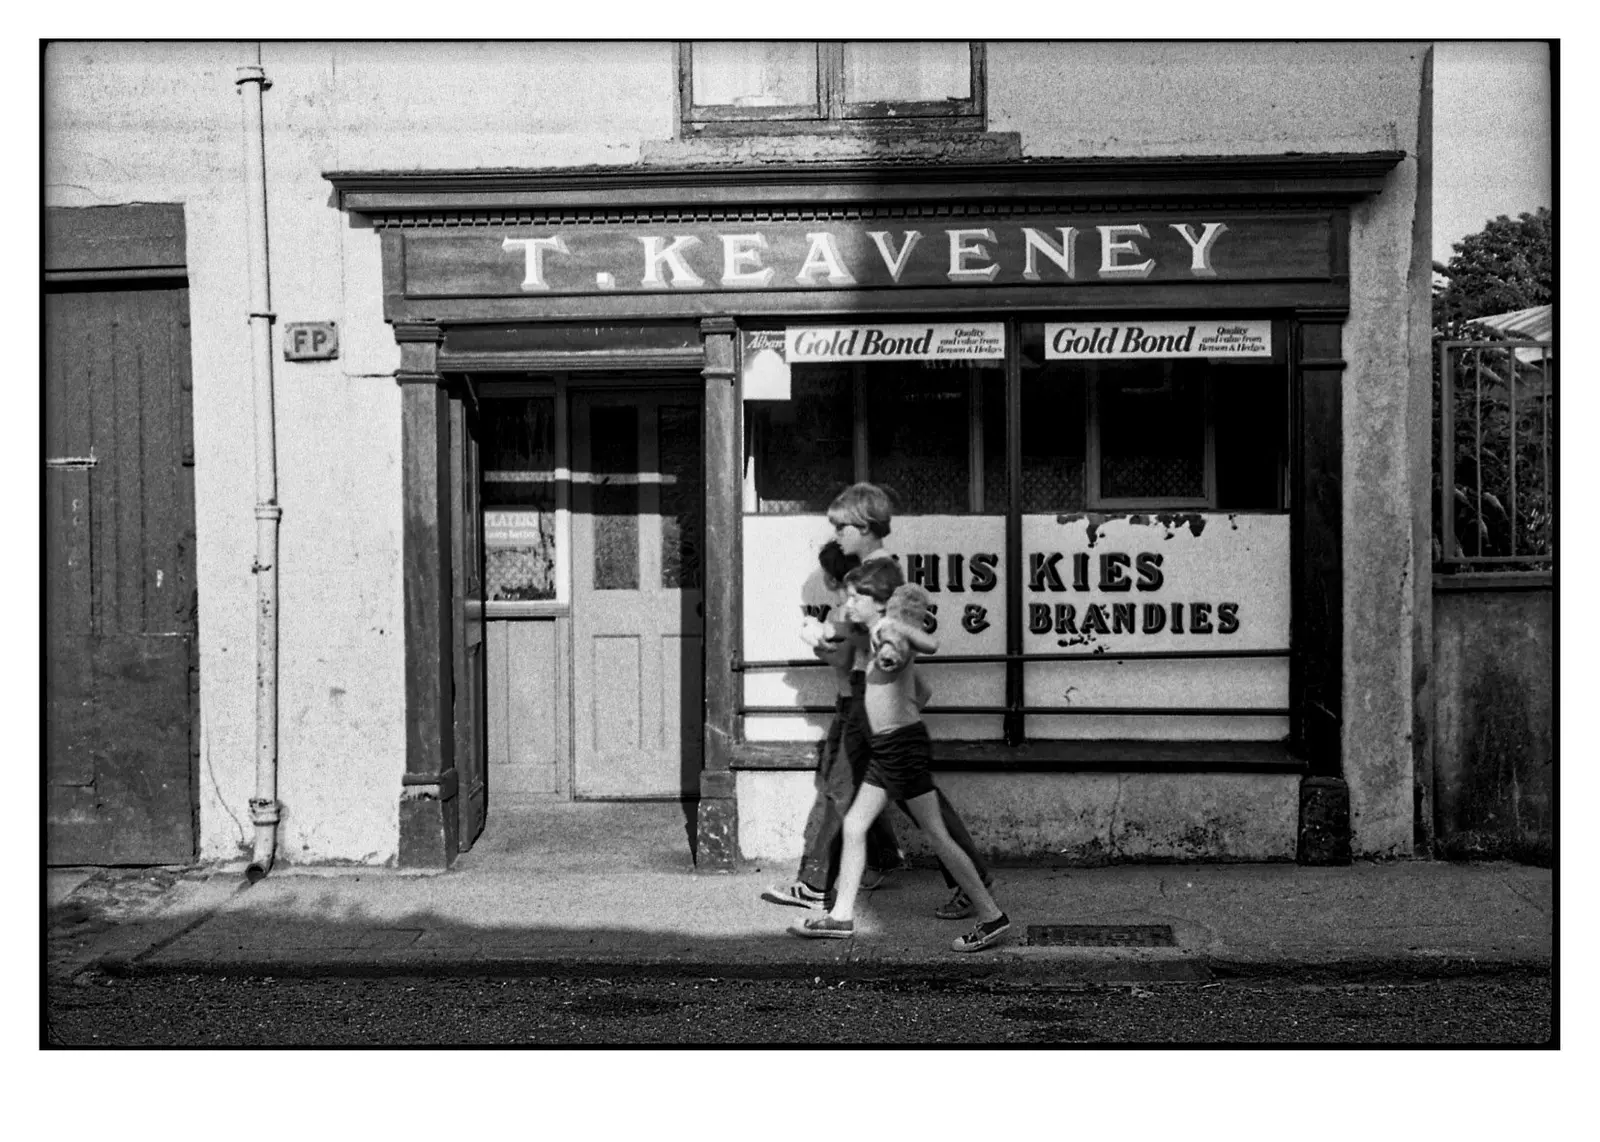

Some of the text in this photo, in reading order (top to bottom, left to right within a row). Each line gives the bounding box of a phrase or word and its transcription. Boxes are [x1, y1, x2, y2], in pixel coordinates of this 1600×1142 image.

[637, 223, 1229, 289] KEAVENEY
[294, 329, 328, 353] FP
[794, 328, 934, 356] Gold Bond
[954, 328, 986, 338] Quality
[1052, 326, 1196, 354] Gold Bond
[1216, 326, 1249, 336] Quality
[936, 345, 966, 354] Benson
[974, 345, 1002, 354] Hedges
[1198, 343, 1228, 352] Benson
[1237, 343, 1265, 352] Hedges
[961, 603, 991, 634] &
[1028, 603, 1240, 635] BRANDIES
